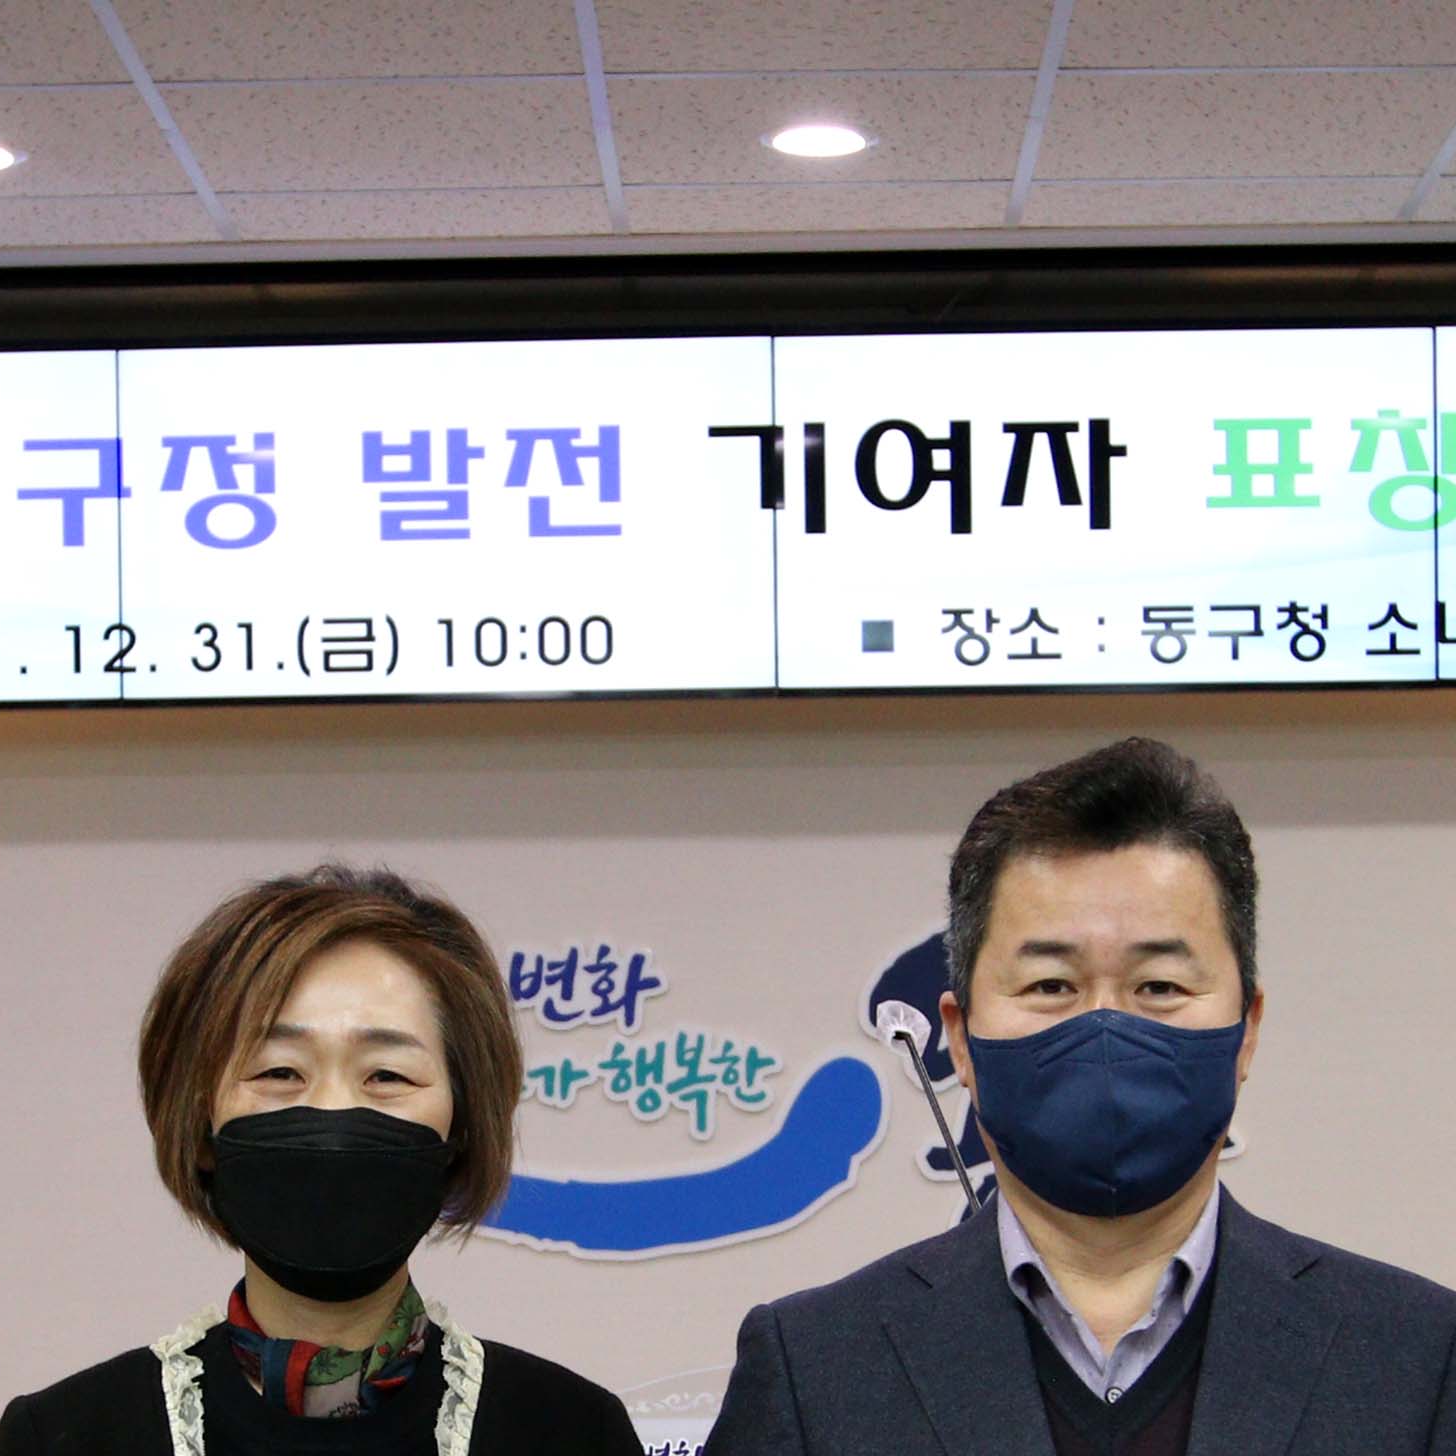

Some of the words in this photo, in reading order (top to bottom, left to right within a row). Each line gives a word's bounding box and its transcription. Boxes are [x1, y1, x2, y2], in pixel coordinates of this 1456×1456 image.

[17, 432, 277, 550] 구정
[362, 425, 622, 541] 발전
[707, 417, 1128, 535] 기여자
[64, 623, 157, 675] 12.
[191, 615, 399, 677] 31.(금)
[437, 614, 614, 668] 10:00
[941, 607, 1063, 665] 장소
[1141, 600, 1330, 665] 동구청
[509, 944, 661, 1027] 변화
[521, 1058, 589, 1101] 가
[597, 1030, 777, 1133] 행복한
